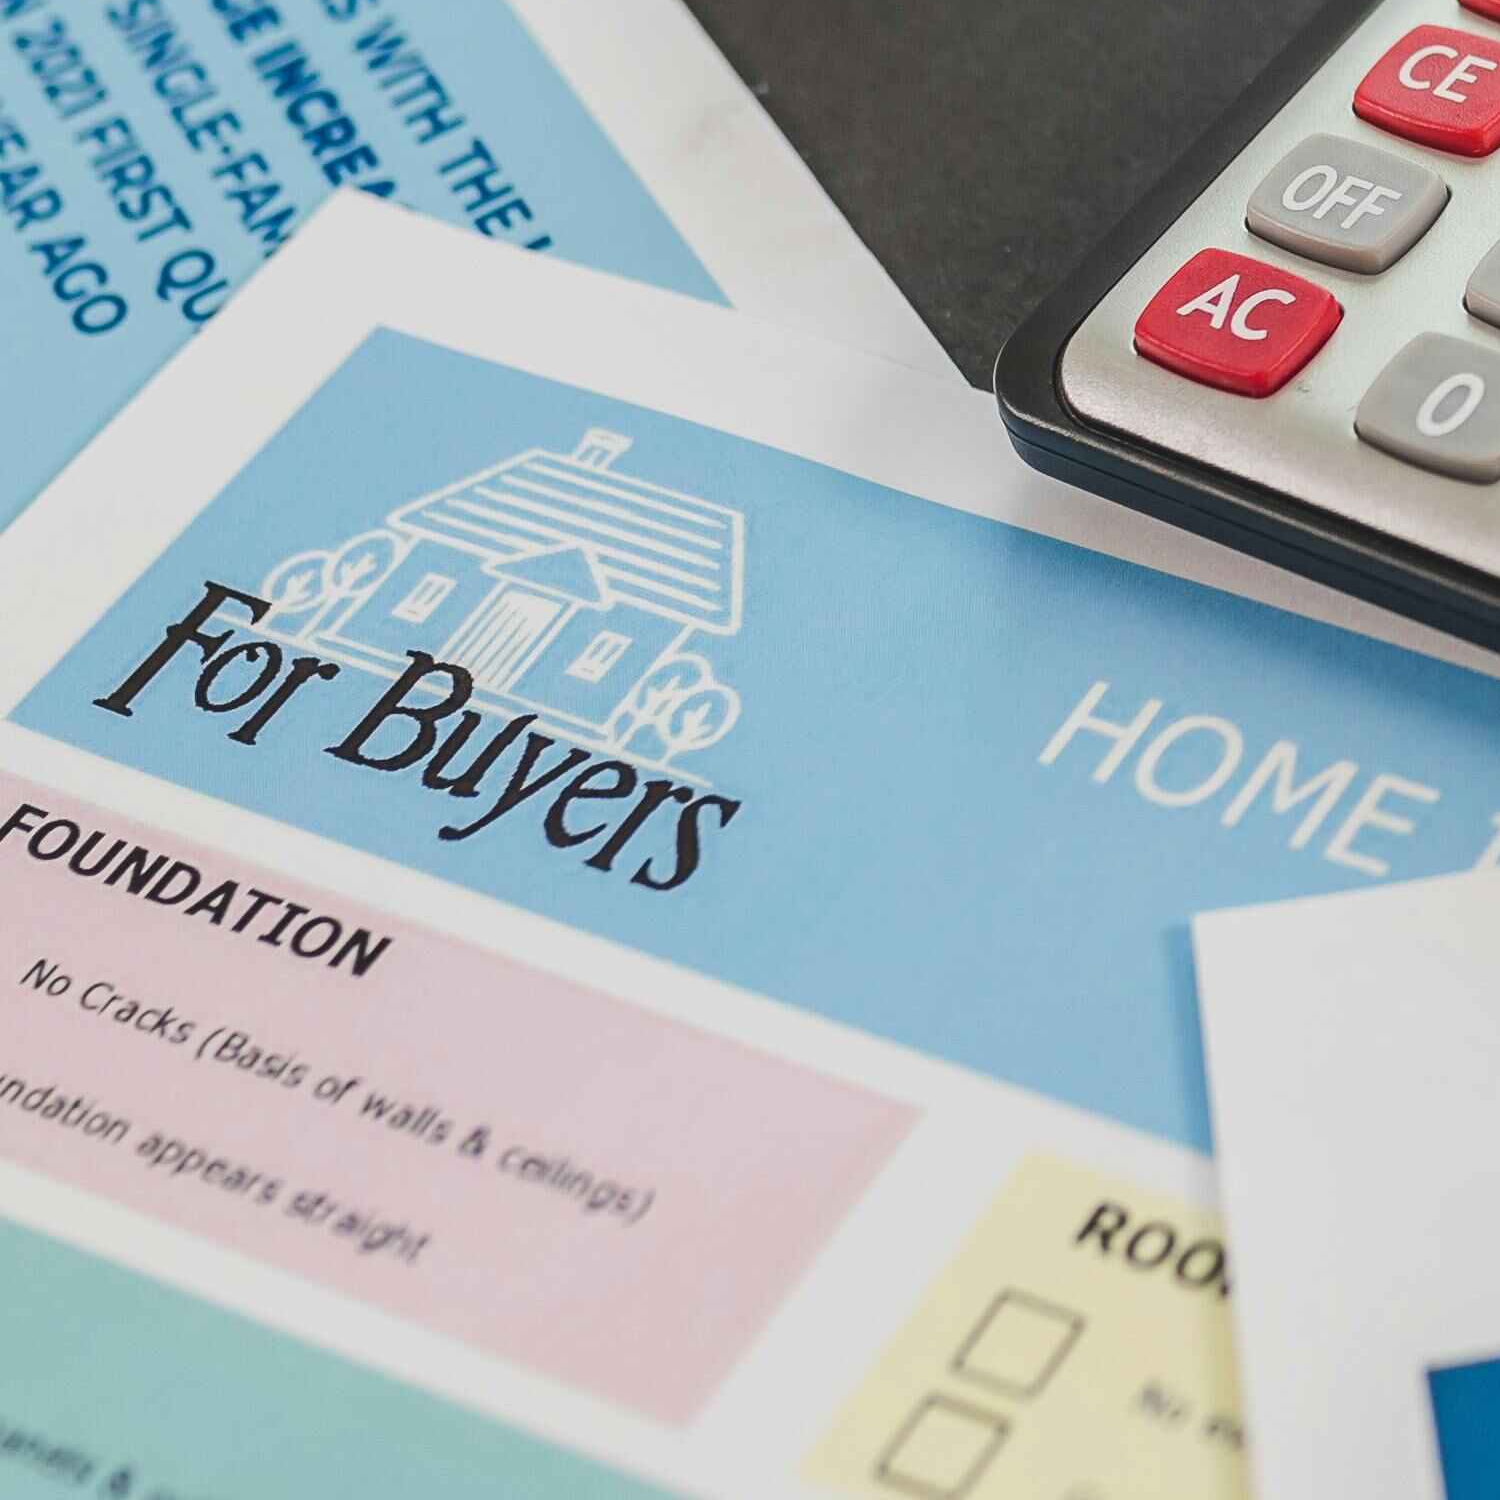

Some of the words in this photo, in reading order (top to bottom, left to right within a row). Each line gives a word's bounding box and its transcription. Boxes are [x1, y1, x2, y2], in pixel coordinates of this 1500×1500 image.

[352, 6, 468, 148] WITH
[436, 135, 532, 242] THE
[1398, 44, 1497, 104] CE
[0, 117, 62, 231] EAR
[13, 11, 109, 122] 2021
[76, 114, 193, 244] FIRST
[155, 247, 229, 328] QU
[1281, 164, 1403, 231] OFF
[28, 234, 128, 335] AGO
[1175, 273, 1296, 343] AC
[1414, 371, 1487, 439] 0
[93, 579, 340, 747] For
[323, 650, 742, 892] Buyers
[1037, 679, 1441, 879] HOME
[0, 802, 393, 978] FOUNDATION
[20, 956, 71, 1001] No
[78, 980, 200, 1049] Cracks
[194, 1024, 307, 1092] (Basis
[312, 1074, 364, 1109] of
[357, 1090, 455, 1148] walls
[458, 1124, 494, 1161] &
[494, 1143, 657, 1226] ceilings)
[136, 1128, 281, 1205] appears
[284, 1187, 435, 1267] straight
[1073, 1199, 1234, 1299] ROO
